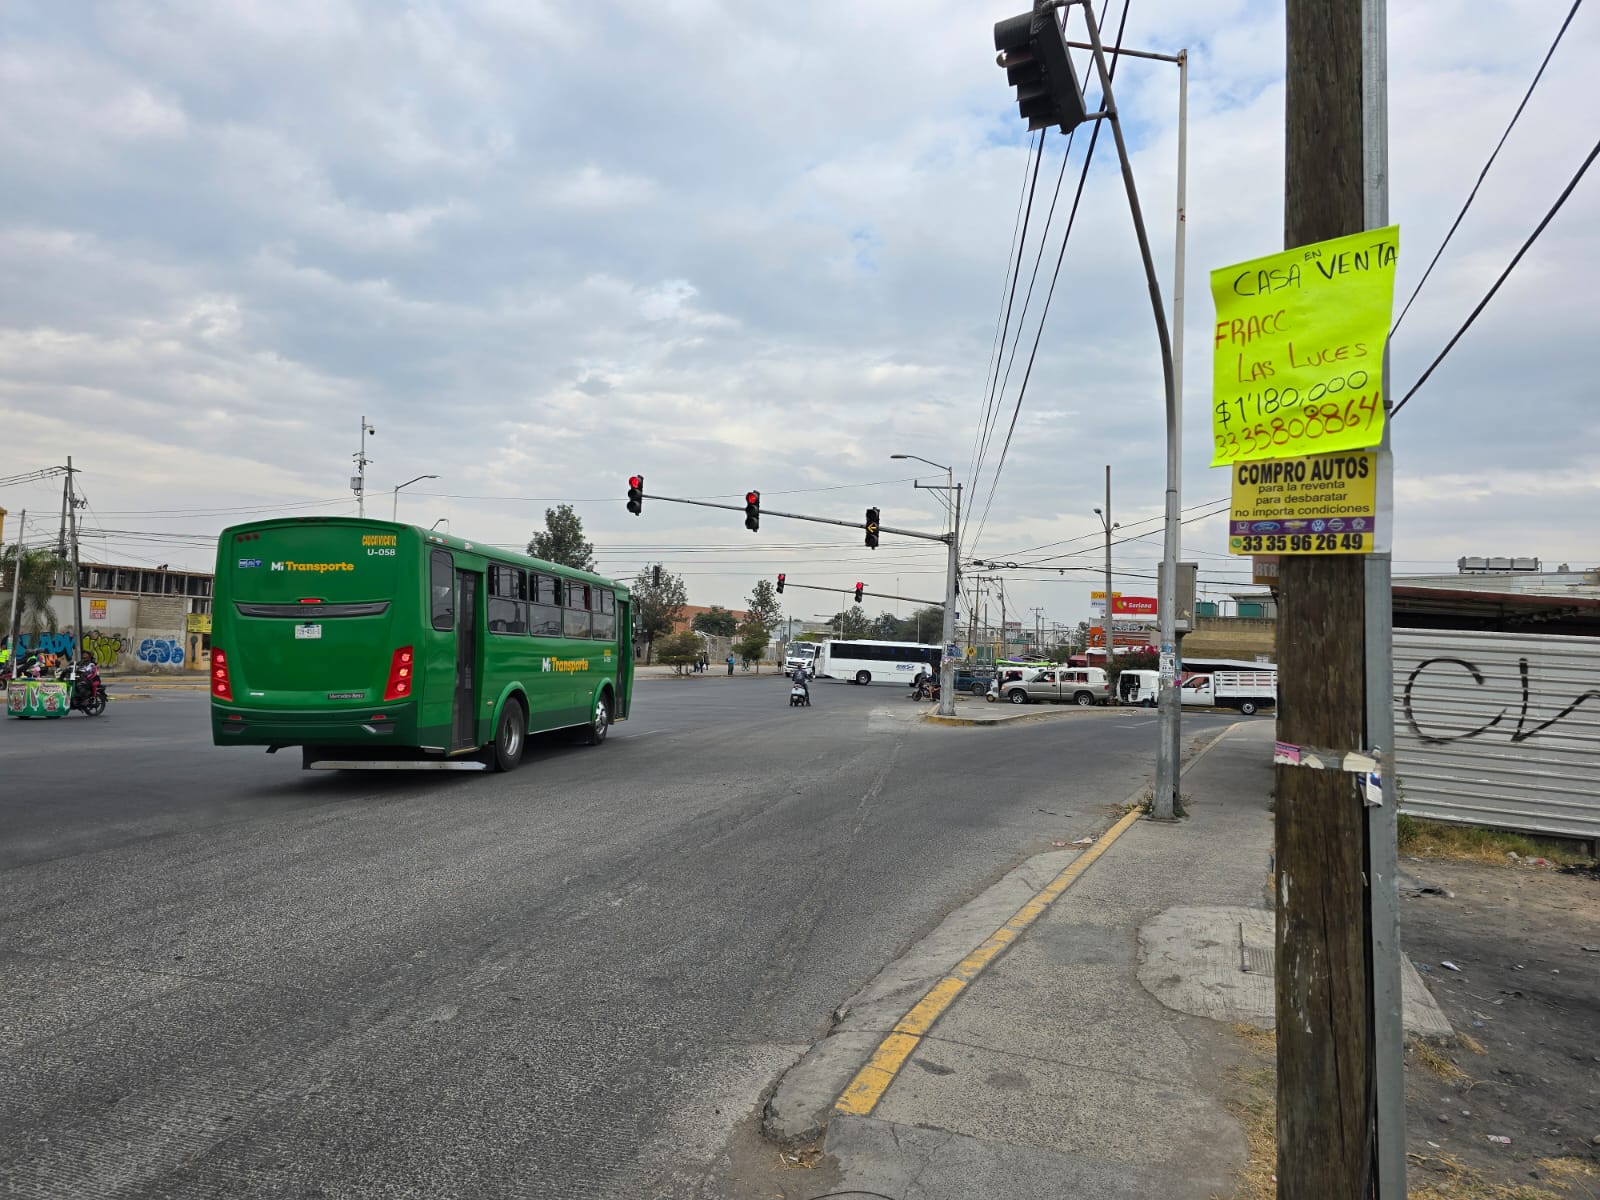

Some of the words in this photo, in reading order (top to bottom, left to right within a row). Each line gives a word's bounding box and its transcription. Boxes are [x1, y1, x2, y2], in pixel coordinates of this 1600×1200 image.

[1233, 262, 1301, 296] CASA
[1304, 249, 1322, 262] EN
[1316, 241, 1397, 280] VENTA
[1215, 309, 1287, 350] FRACC
[1238, 352, 1276, 383] LAS
[1288, 341, 1368, 369] LUCES
[1238, 462, 1306, 485] COMPRO
[1311, 456, 1369, 481] AUTOS
[1258, 484, 1284, 495] para
[1287, 482, 1297, 492] la
[1300, 480, 1345, 491] reventa
[1255, 496, 1281, 506] para
[1284, 492, 1348, 504] desbaratar
[1235, 509, 1249, 517] no
[1252, 506, 1295, 519] importa
[1297, 504, 1370, 515] condiciones
[1242, 536, 1263, 551] 33
[1266, 535, 1287, 551] 35
[1290, 535, 1312, 551] 96
[1315, 534, 1337, 551] 26
[1340, 533, 1363, 550] 49
[367, 548, 396, 556] U-058
[271, 562, 284, 571] Mi
[286, 562, 354, 573] Transporte
[542, 657, 551, 672] Mi
[552, 657, 588, 676] Transporte
